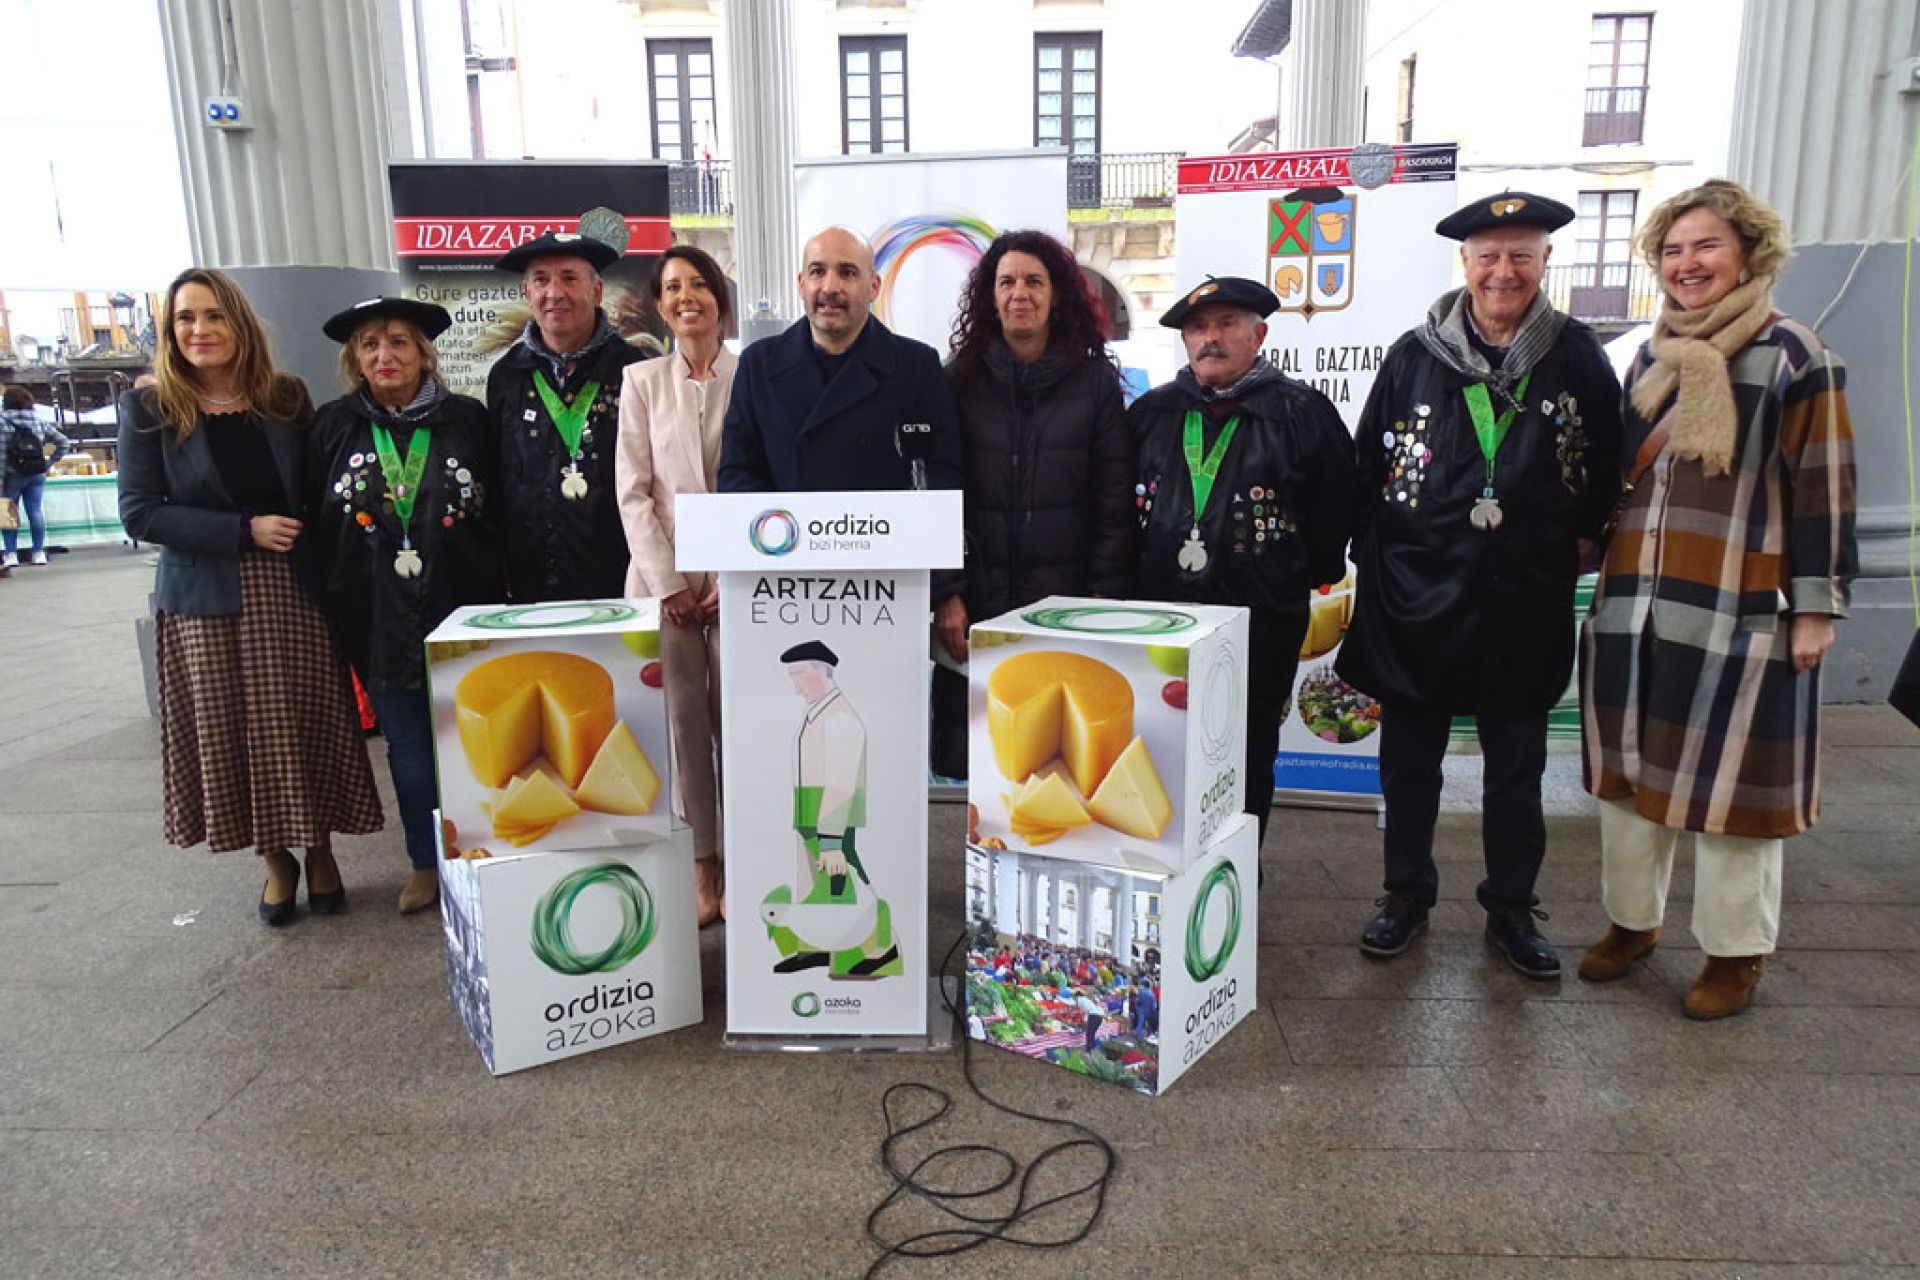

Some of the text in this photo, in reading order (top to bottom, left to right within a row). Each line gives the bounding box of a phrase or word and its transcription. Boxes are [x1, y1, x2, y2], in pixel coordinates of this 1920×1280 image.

[1207, 156, 1342, 183] IDIAZABAL
[415, 284, 461, 302] Gure
[807, 513, 890, 536] ordizia
[808, 538, 871, 551] bizi herria
[753, 577, 896, 601] ARTZAIN
[751, 601, 896, 626] EGUNA
[1200, 766, 1236, 814] ordizia
[544, 978, 655, 1023] ordizia
[824, 996, 862, 1008] azoka
[1185, 976, 1237, 1035] ordizia
[546, 1005, 657, 1051] azoka
[1183, 1003, 1236, 1065] azoka
